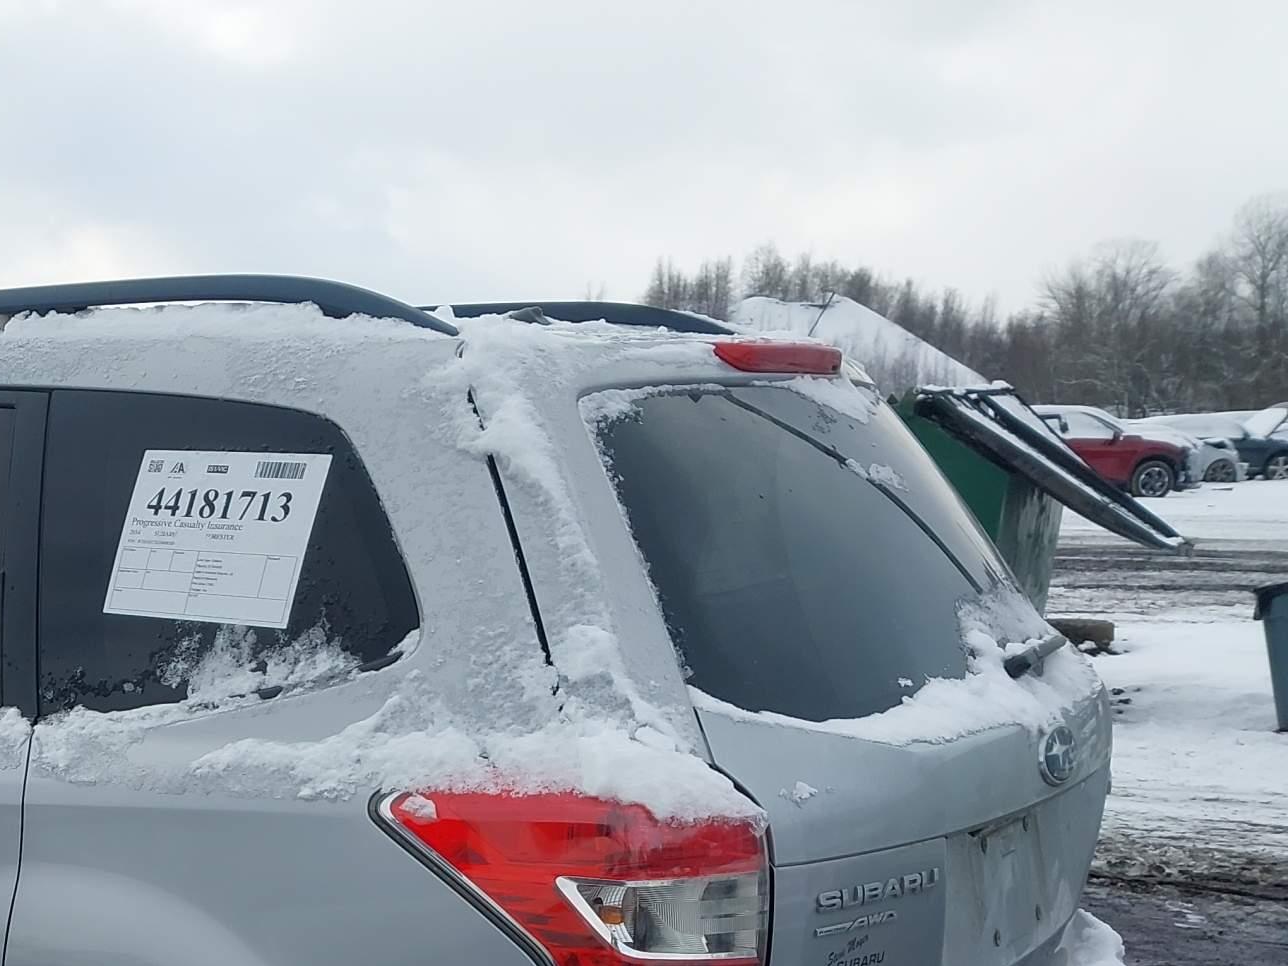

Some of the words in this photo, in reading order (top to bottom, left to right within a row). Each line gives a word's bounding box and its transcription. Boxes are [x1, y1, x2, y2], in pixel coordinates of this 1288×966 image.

[146, 487, 294, 523] 44181713
[132, 517, 172, 529] Progressive
[174, 519, 205, 531] Casualty
[206, 521, 243, 531] Insurance
[816, 868, 939, 912] SUBARU
